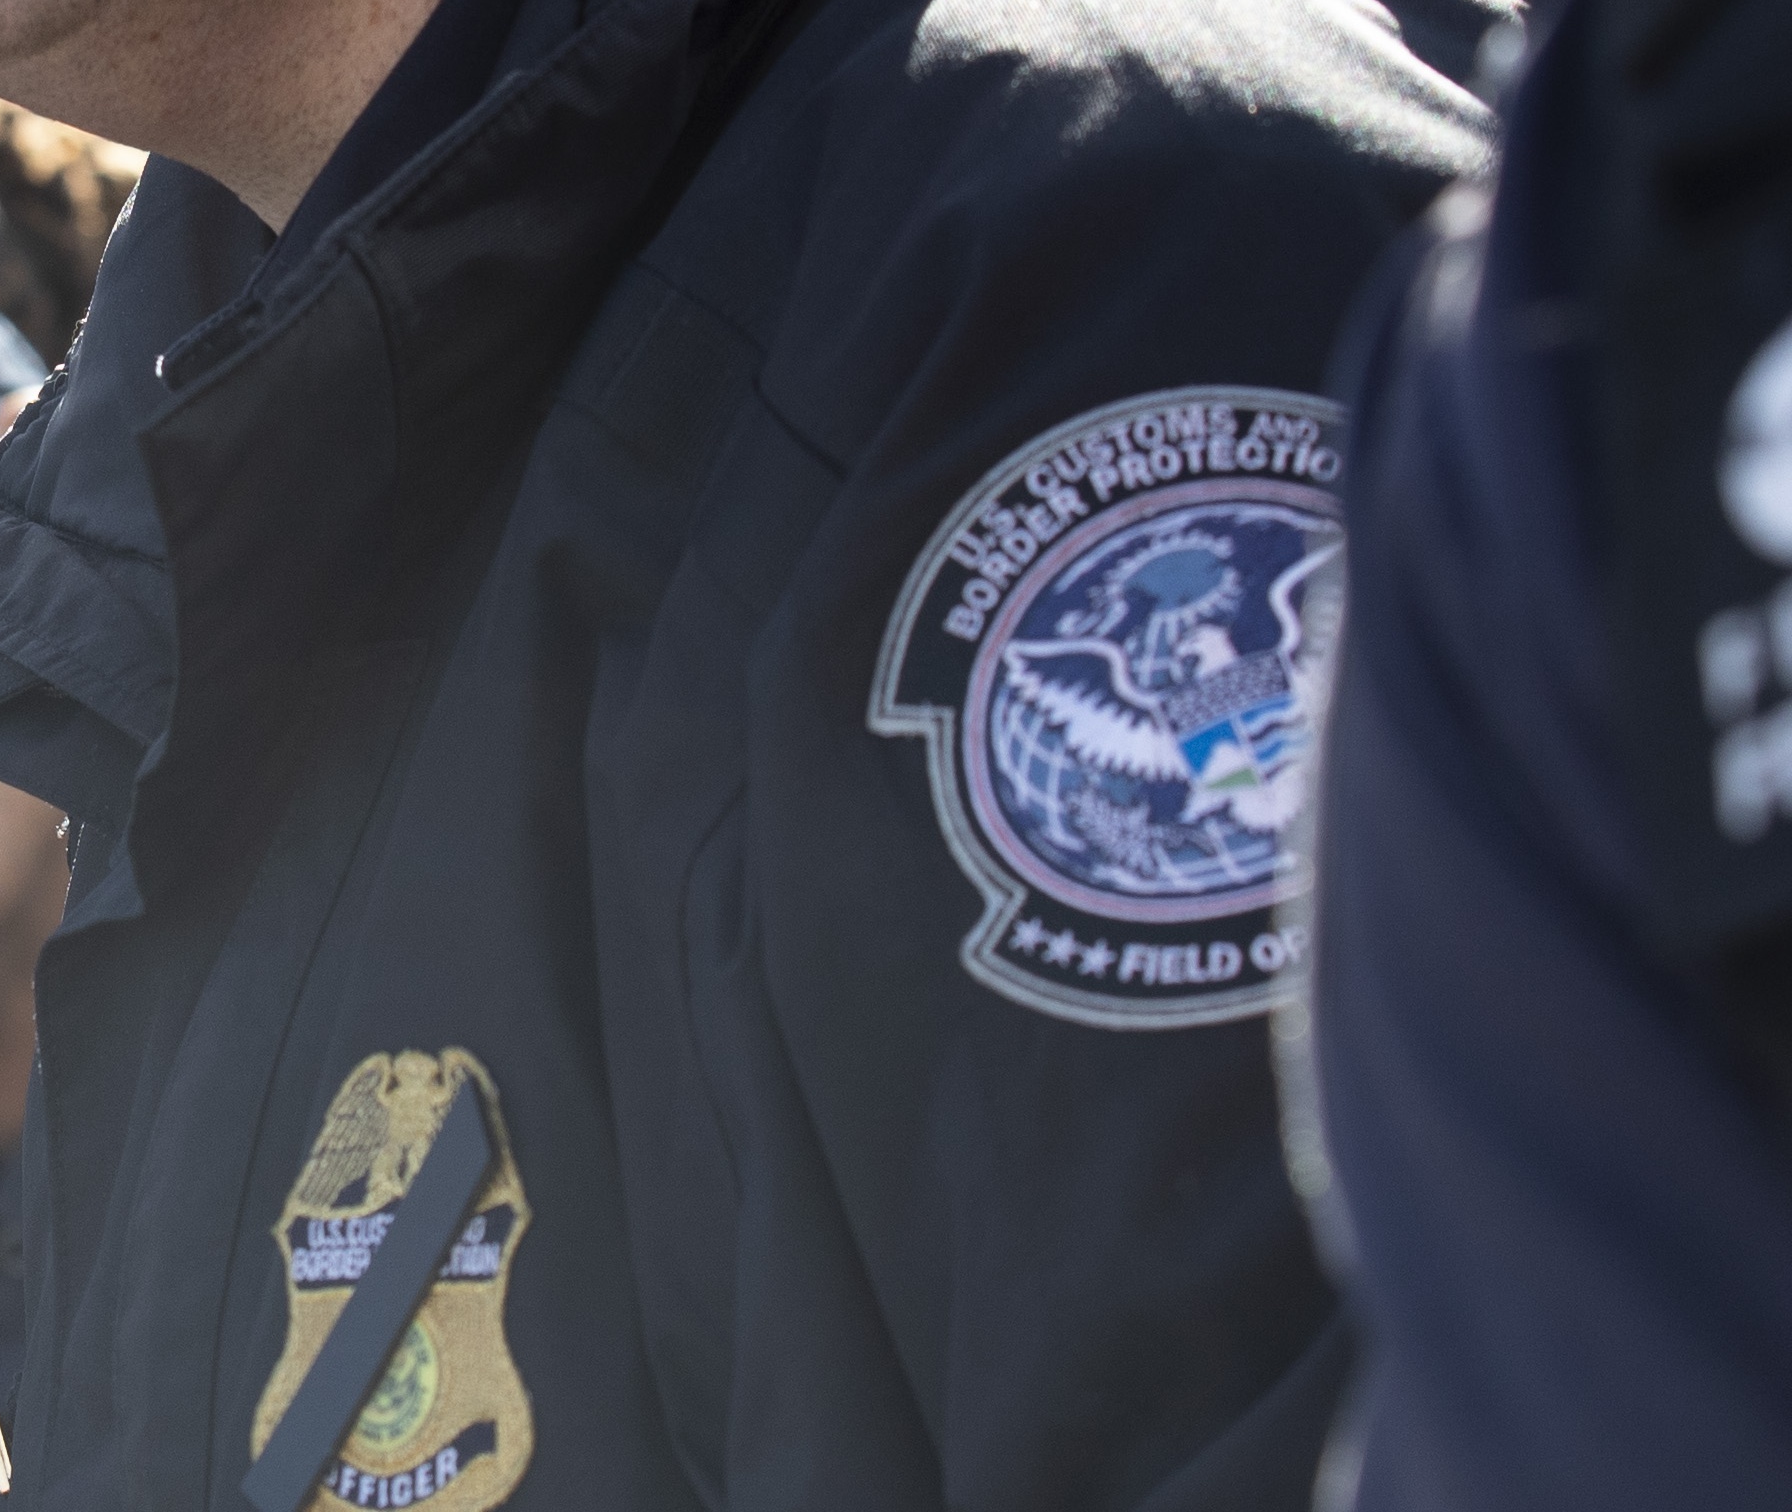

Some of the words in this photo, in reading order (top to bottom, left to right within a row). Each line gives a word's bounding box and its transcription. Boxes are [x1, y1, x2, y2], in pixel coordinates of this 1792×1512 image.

[942, 487, 1089, 641] BORDER
[1089, 436, 1340, 502] PROTECTIO
[949, 498, 1028, 570] U.S.
[1025, 403, 1237, 497] CUSTOMS
[1248, 413, 1319, 445] AND
[1117, 941, 1243, 985] FIELD
